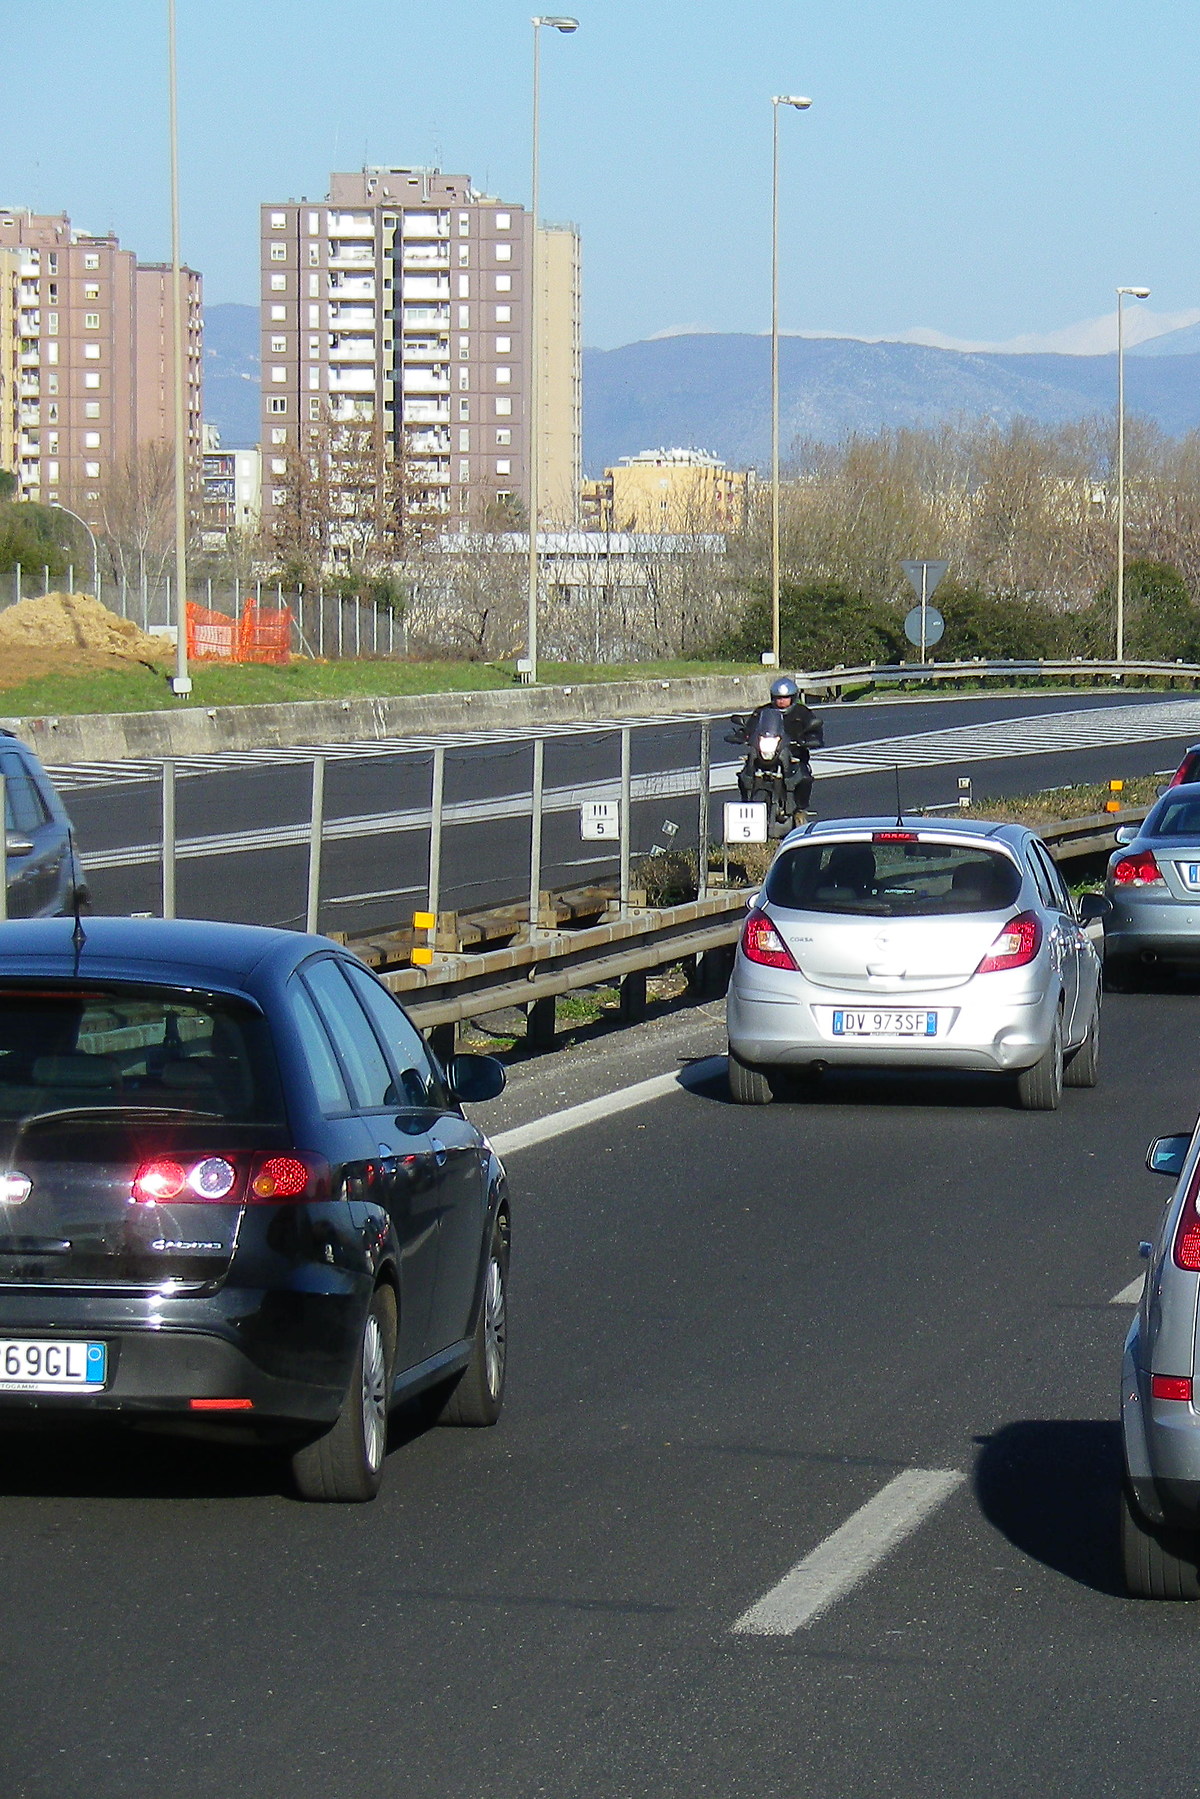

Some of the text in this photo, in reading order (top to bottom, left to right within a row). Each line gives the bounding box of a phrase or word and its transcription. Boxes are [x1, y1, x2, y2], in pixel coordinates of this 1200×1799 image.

[596, 823, 605, 835] 5
[743, 826, 751, 838] 5
[846, 1014, 924, 1030] DV 973SF
[0, 1345, 82, 1377] 69GL
